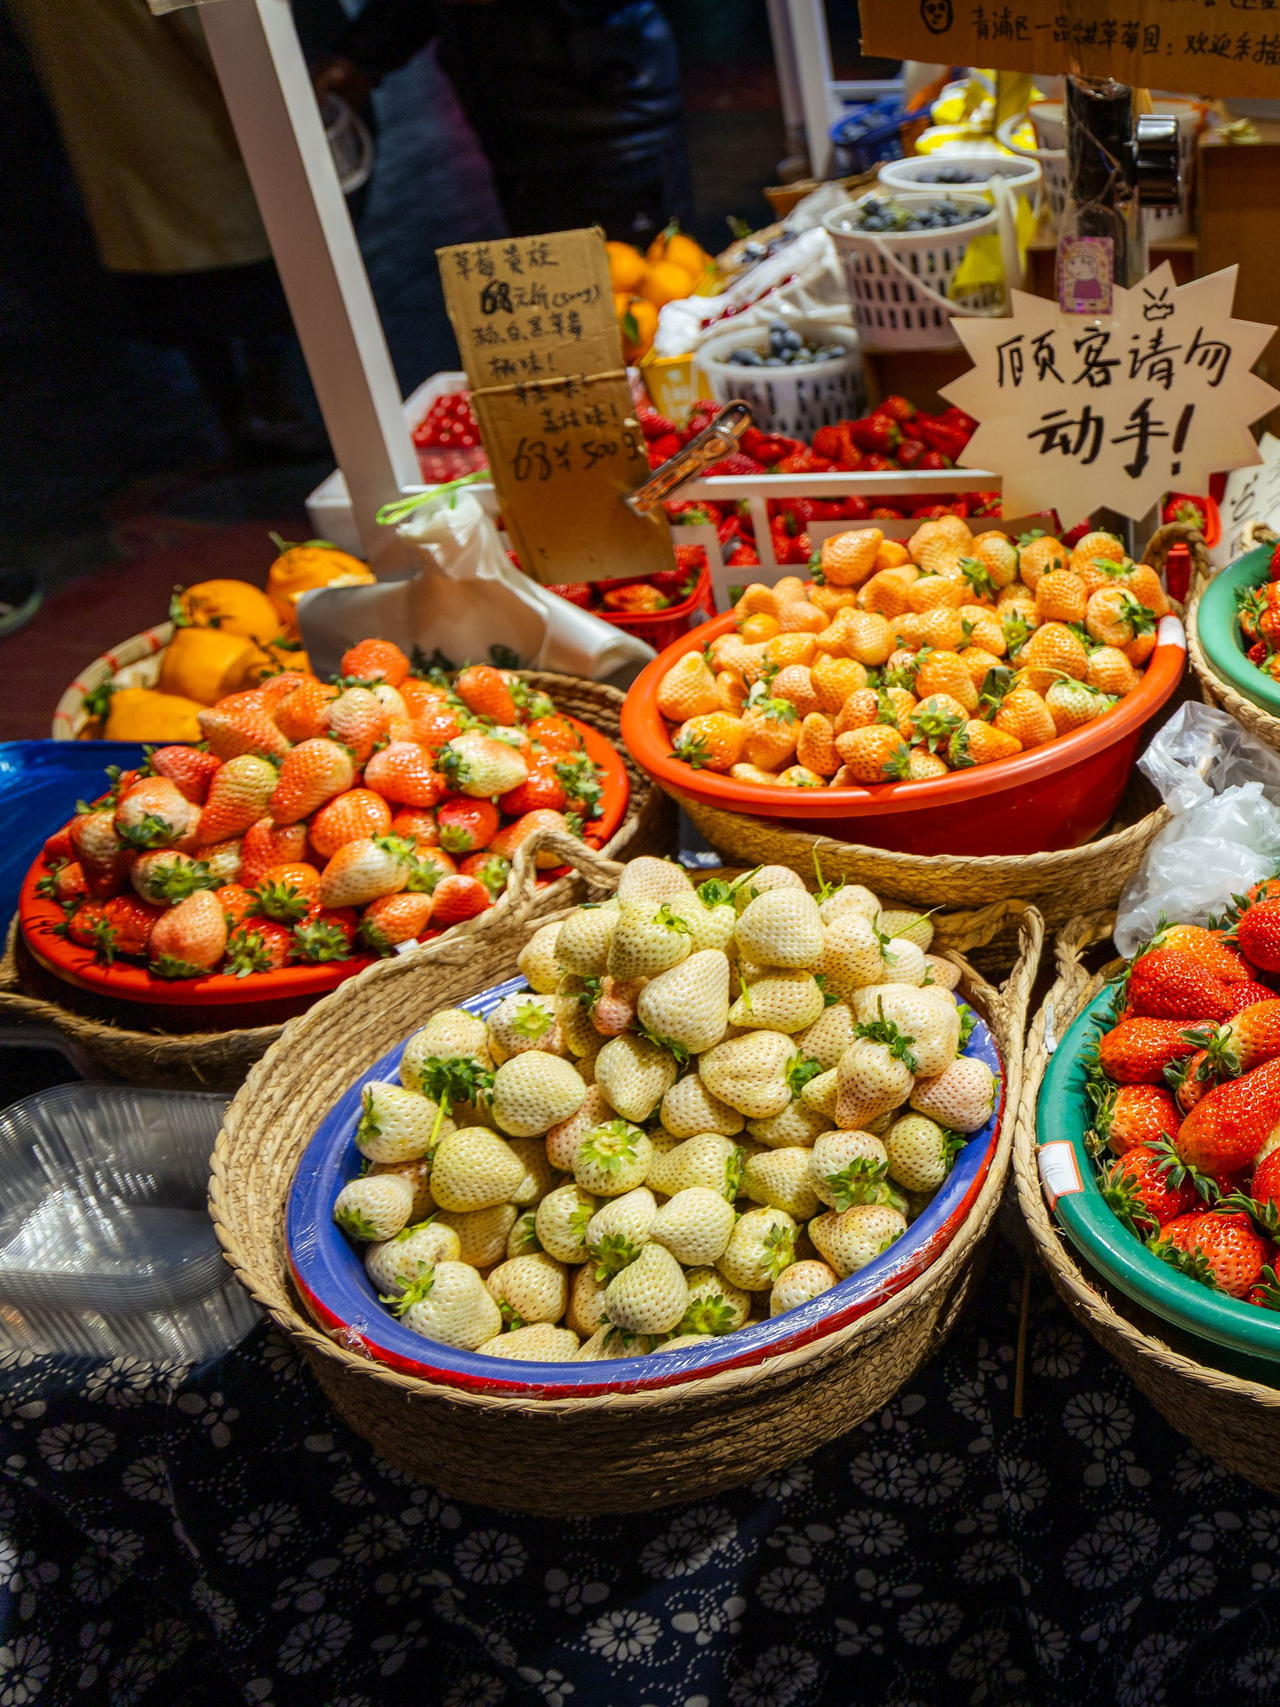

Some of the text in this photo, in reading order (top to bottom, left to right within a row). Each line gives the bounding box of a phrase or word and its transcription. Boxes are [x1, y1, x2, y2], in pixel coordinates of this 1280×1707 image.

[995, 325, 1233, 391] 顾客请勿
[1026, 396, 1198, 480] 动手！
